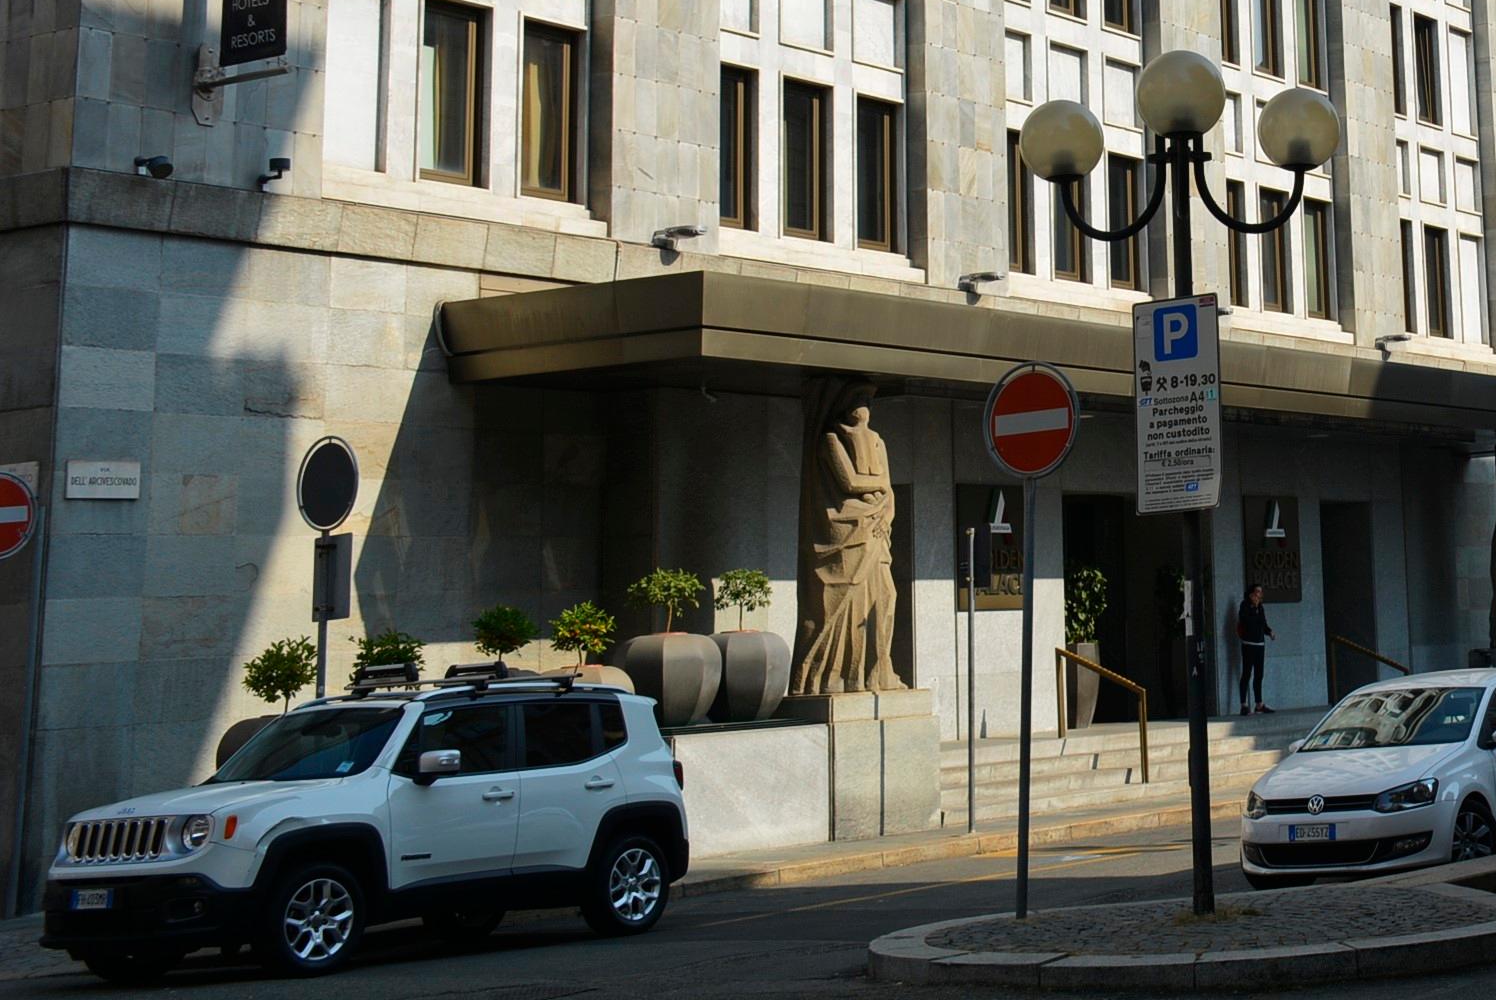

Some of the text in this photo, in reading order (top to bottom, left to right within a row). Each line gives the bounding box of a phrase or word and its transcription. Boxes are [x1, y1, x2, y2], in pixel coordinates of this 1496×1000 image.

[247, 14, 256, 27] &
[231, 28, 276, 48] RESORTS
[1163, 312, 1189, 354] P
[1153, 395, 1189, 405] Sottozona
[1190, 391, 1204, 403] A4
[1152, 403, 1204, 416] Parcheggio
[1156, 415, 1208, 429] pagamento
[1147, 427, 1210, 440] non custodito
[1144, 445, 1215, 459] Tariffa ordinaria:
[88, 476, 137, 486] ARCIVESCOVADO
[1255, 551, 1298, 569] GOLDEN
